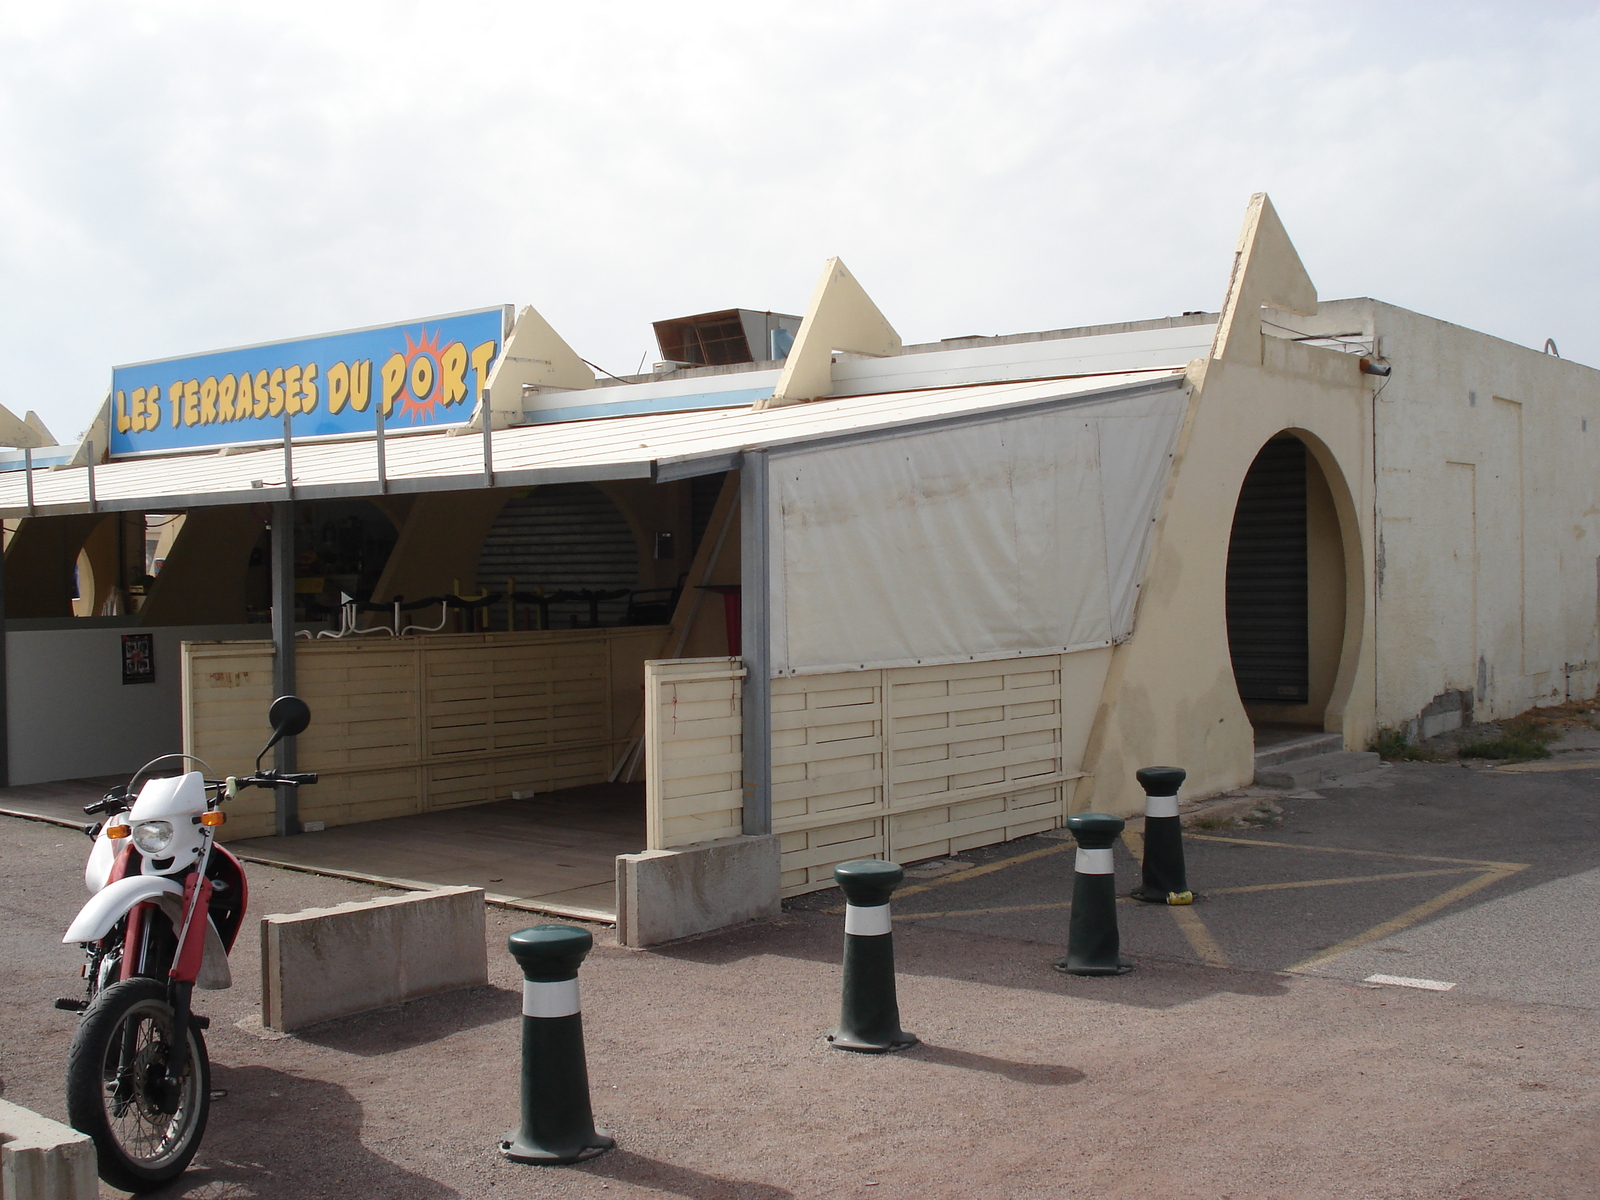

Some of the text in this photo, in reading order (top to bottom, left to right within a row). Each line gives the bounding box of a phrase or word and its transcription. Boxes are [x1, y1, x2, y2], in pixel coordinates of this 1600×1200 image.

[116, 340, 497, 434] LES TERRASSES DU PORT
